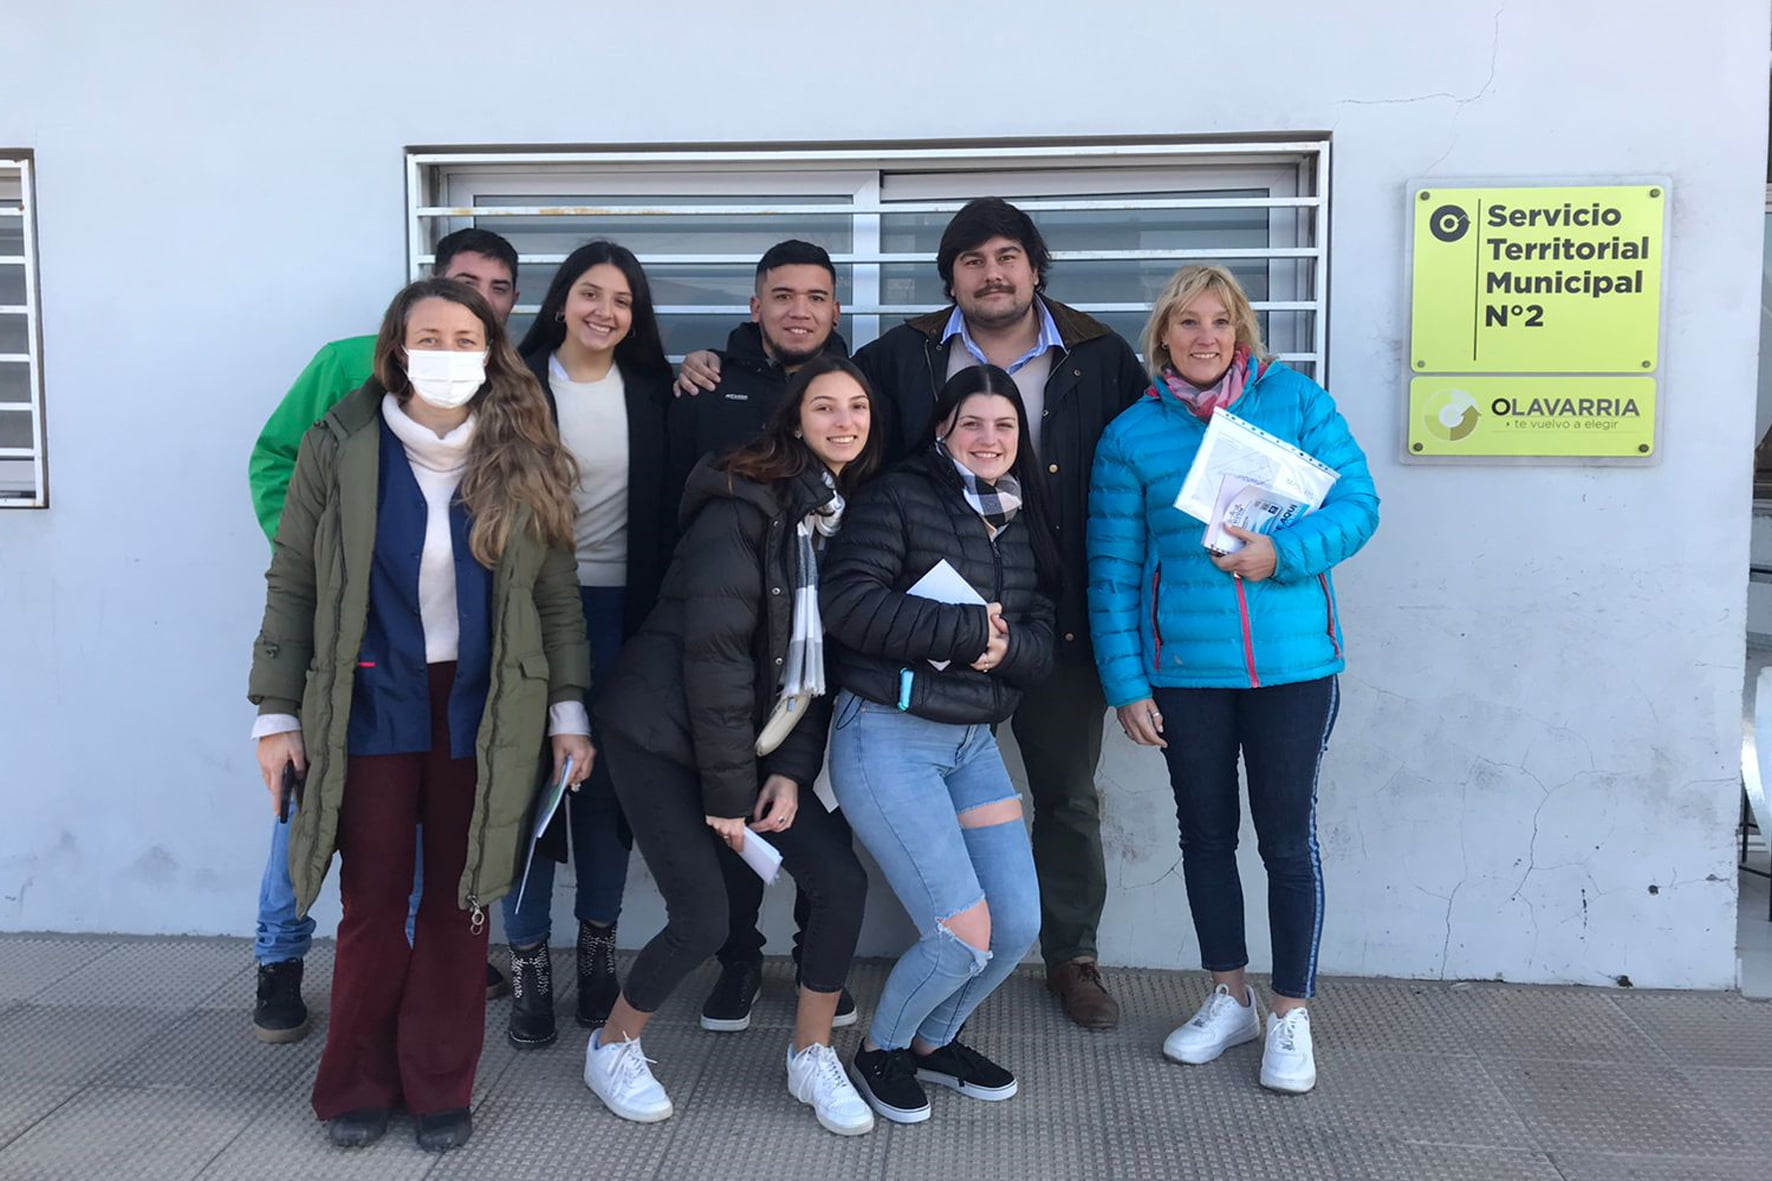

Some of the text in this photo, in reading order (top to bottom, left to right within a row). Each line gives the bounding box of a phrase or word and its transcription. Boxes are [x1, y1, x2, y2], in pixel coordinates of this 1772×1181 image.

[1487, 203, 1622, 227] Servicio
[1487, 236, 1649, 260] Territorial
[1486, 270, 1643, 298] Municipal
[1485, 304, 1544, 327] N°2
[1491, 398, 1640, 417] OLAVARRIA
[1514, 419, 1619, 430] te vuelvo a elegir
